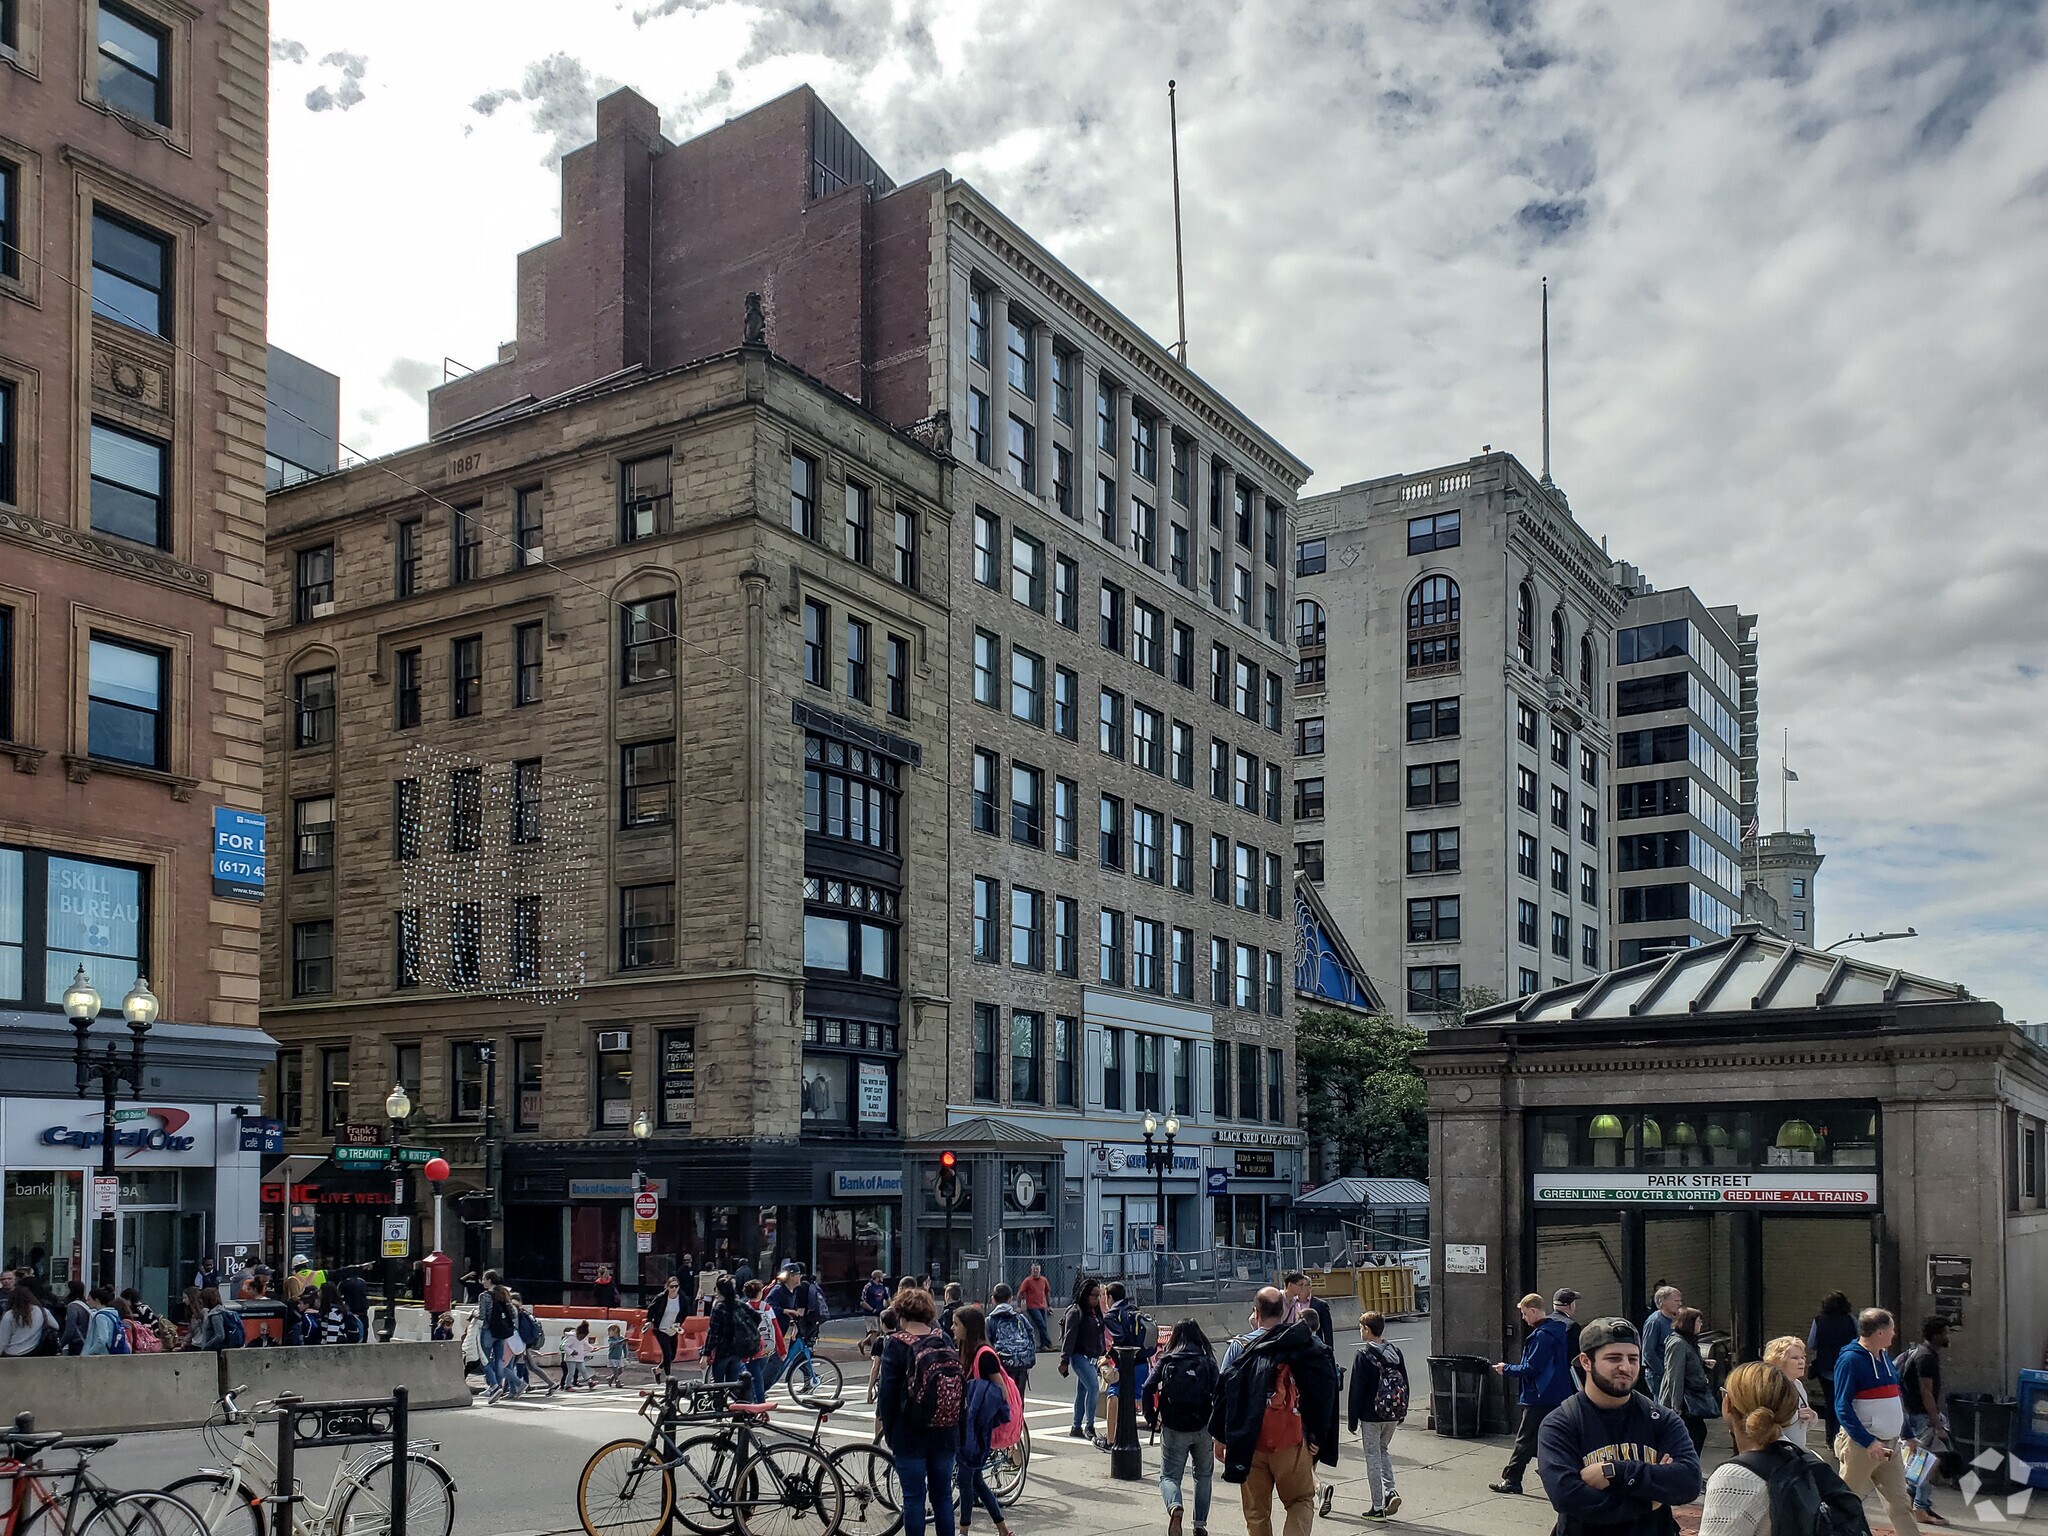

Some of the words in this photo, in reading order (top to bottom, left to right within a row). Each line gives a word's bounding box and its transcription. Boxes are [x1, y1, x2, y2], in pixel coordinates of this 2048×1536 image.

[453, 453, 481, 475] 1887
[219, 832, 253, 851] FOR
[219, 860, 250, 877] (617)
[60, 869, 110, 895] SKILL
[60, 894, 139, 923] BUREAU
[666, 1053, 694, 1061] CUSTOM
[346, 1125, 378, 1135] Frank's
[245, 1137, 258, 1148] café
[349, 1133, 377, 1143] Tailors
[1218, 1130, 1242, 1142] BLACK
[1242, 1132, 1259, 1144] SEED
[1260, 1133, 1277, 1145] CAFE
[1282, 1136, 1301, 1146] GRILL
[348, 1148, 383, 1159] TREMONT
[408, 1150, 431, 1161] WINTER
[572, 1183, 589, 1194] Bank
[590, 1183, 598, 1194] of
[839, 1175, 865, 1190] Bank
[865, 1174, 877, 1189] of
[1648, 1175, 1687, 1187] PARK
[1691, 1175, 1752, 1188] STREET
[15, 1182, 71, 1198] banking
[260, 1184, 320, 1204] GNC
[320, 1193, 353, 1204] LIVE
[354, 1193, 392, 1204] WELL
[1019, 1180, 1032, 1201] T
[1543, 1189, 1580, 1200] GREEN
[1582, 1190, 1606, 1200] LINE
[1615, 1190, 1639, 1200] GOV
[1641, 1190, 1664, 1200] CTR
[1666, 1191, 1674, 1200] &
[1677, 1190, 1716, 1201] NORTH
[1727, 1191, 1752, 1201] RED
[1754, 1191, 1782, 1201] LINE
[1792, 1191, 1815, 1201] ALL
[1817, 1192, 1863, 1202] TRAINS
